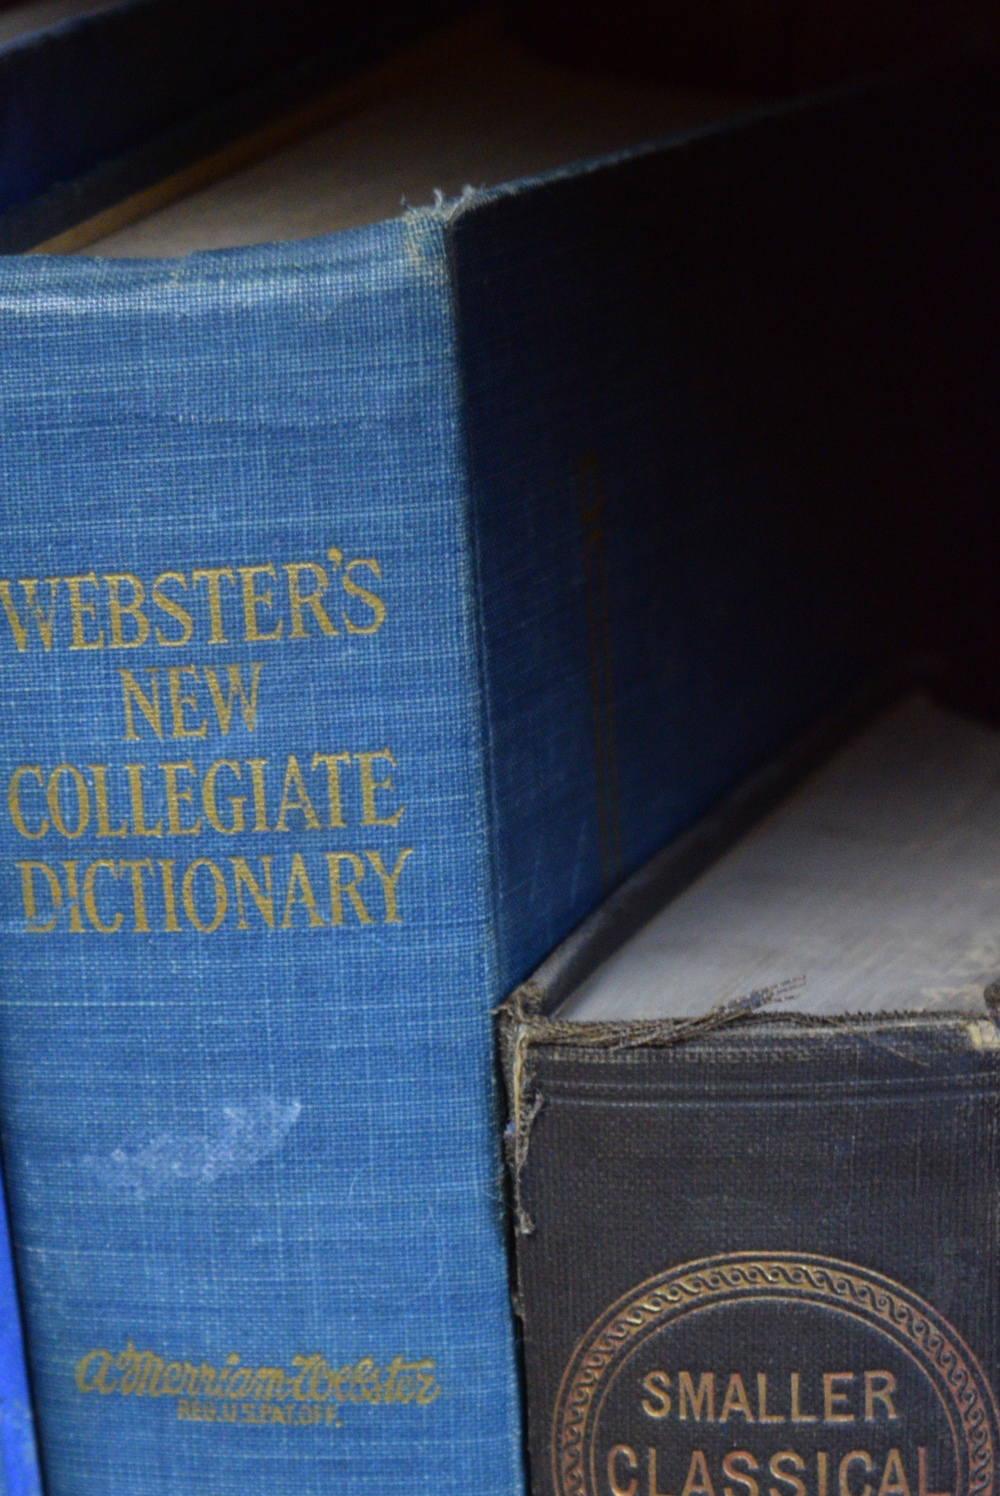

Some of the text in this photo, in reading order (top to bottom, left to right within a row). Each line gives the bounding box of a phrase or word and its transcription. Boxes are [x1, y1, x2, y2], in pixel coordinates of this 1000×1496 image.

[116, 661, 268, 741] NEW
[6, 746, 406, 840] COLLEGIATE
[15, 847, 414, 934] DICTIONARY
[640, 1369, 901, 1425] SMALLER
